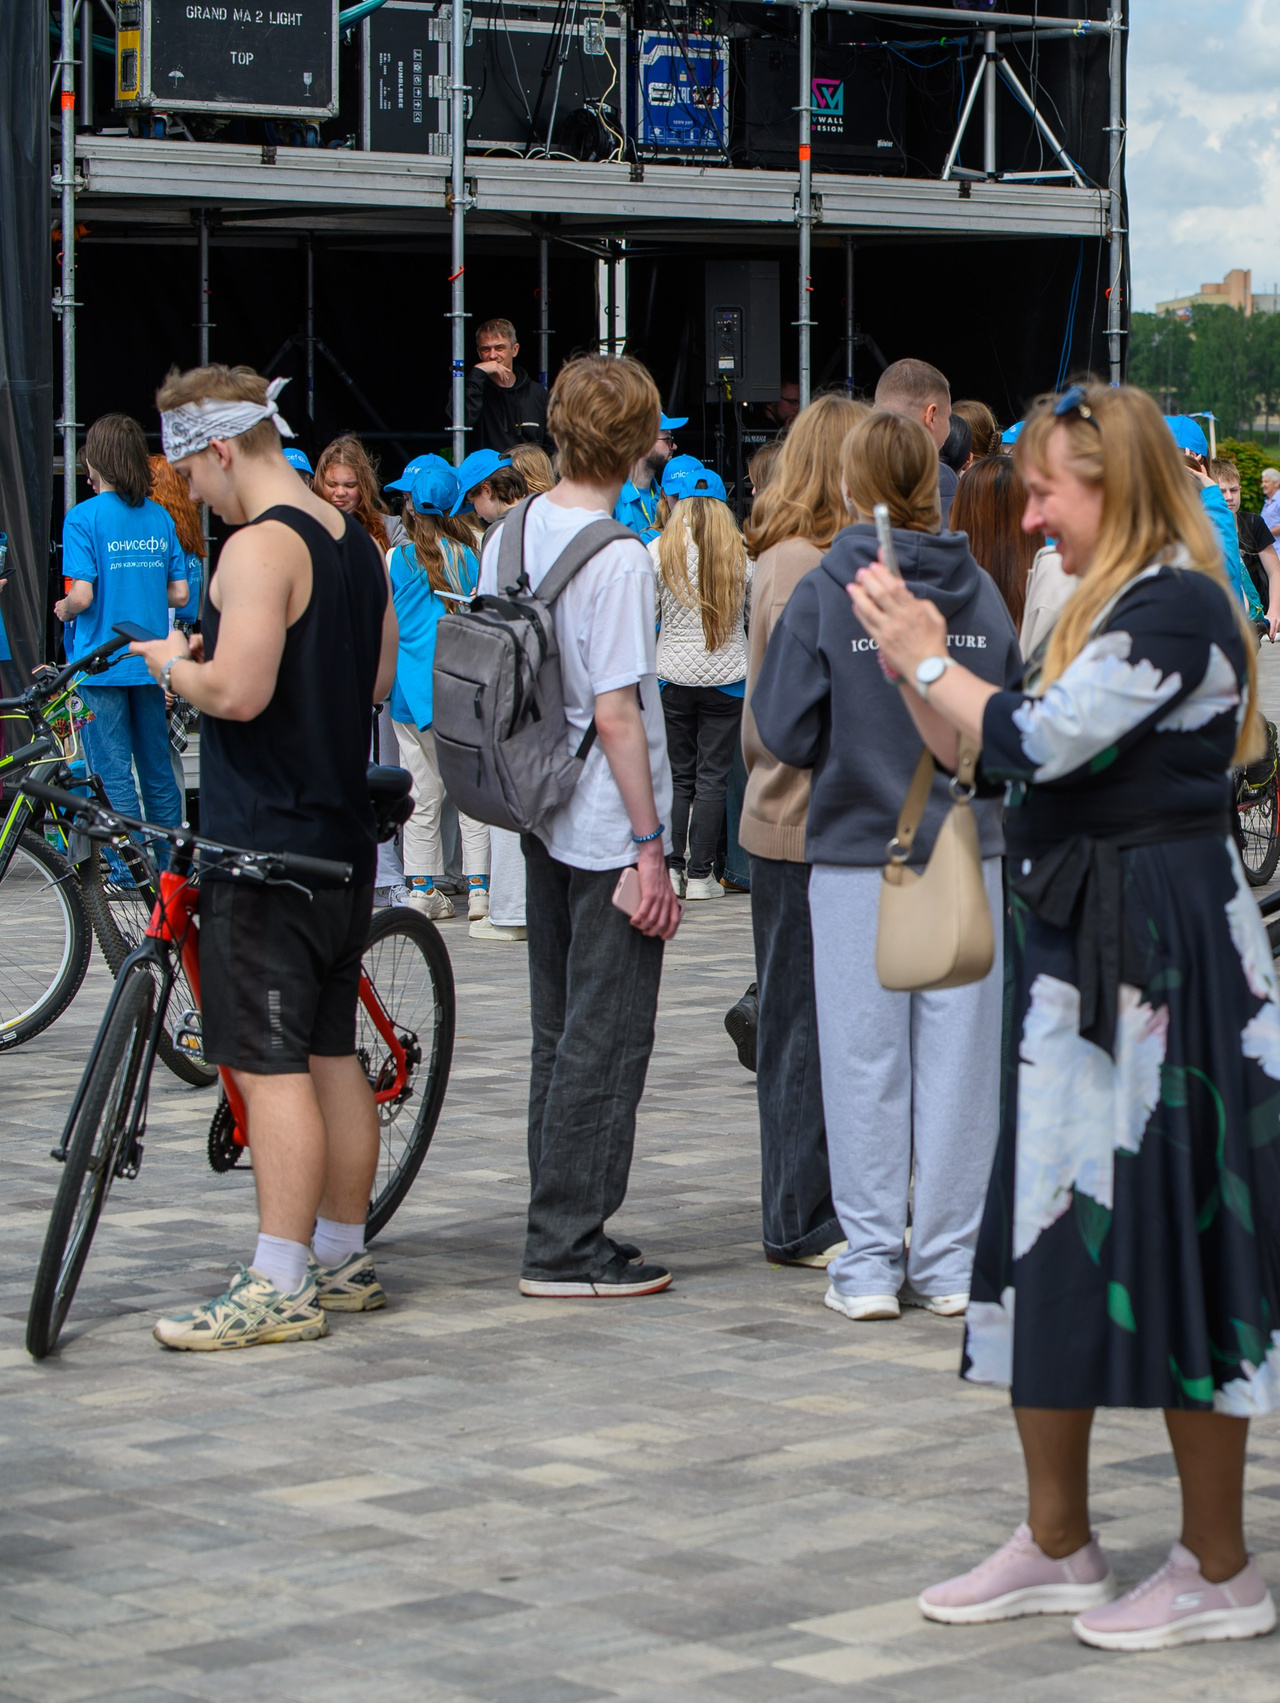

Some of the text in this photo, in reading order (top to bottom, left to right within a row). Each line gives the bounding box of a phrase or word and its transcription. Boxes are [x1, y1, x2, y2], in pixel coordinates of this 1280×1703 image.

[186, 5, 303, 26] GRAND MA 2 LIGHT
[230, 51, 254, 65] TOP
[811, 125, 844, 133] DESIGN
